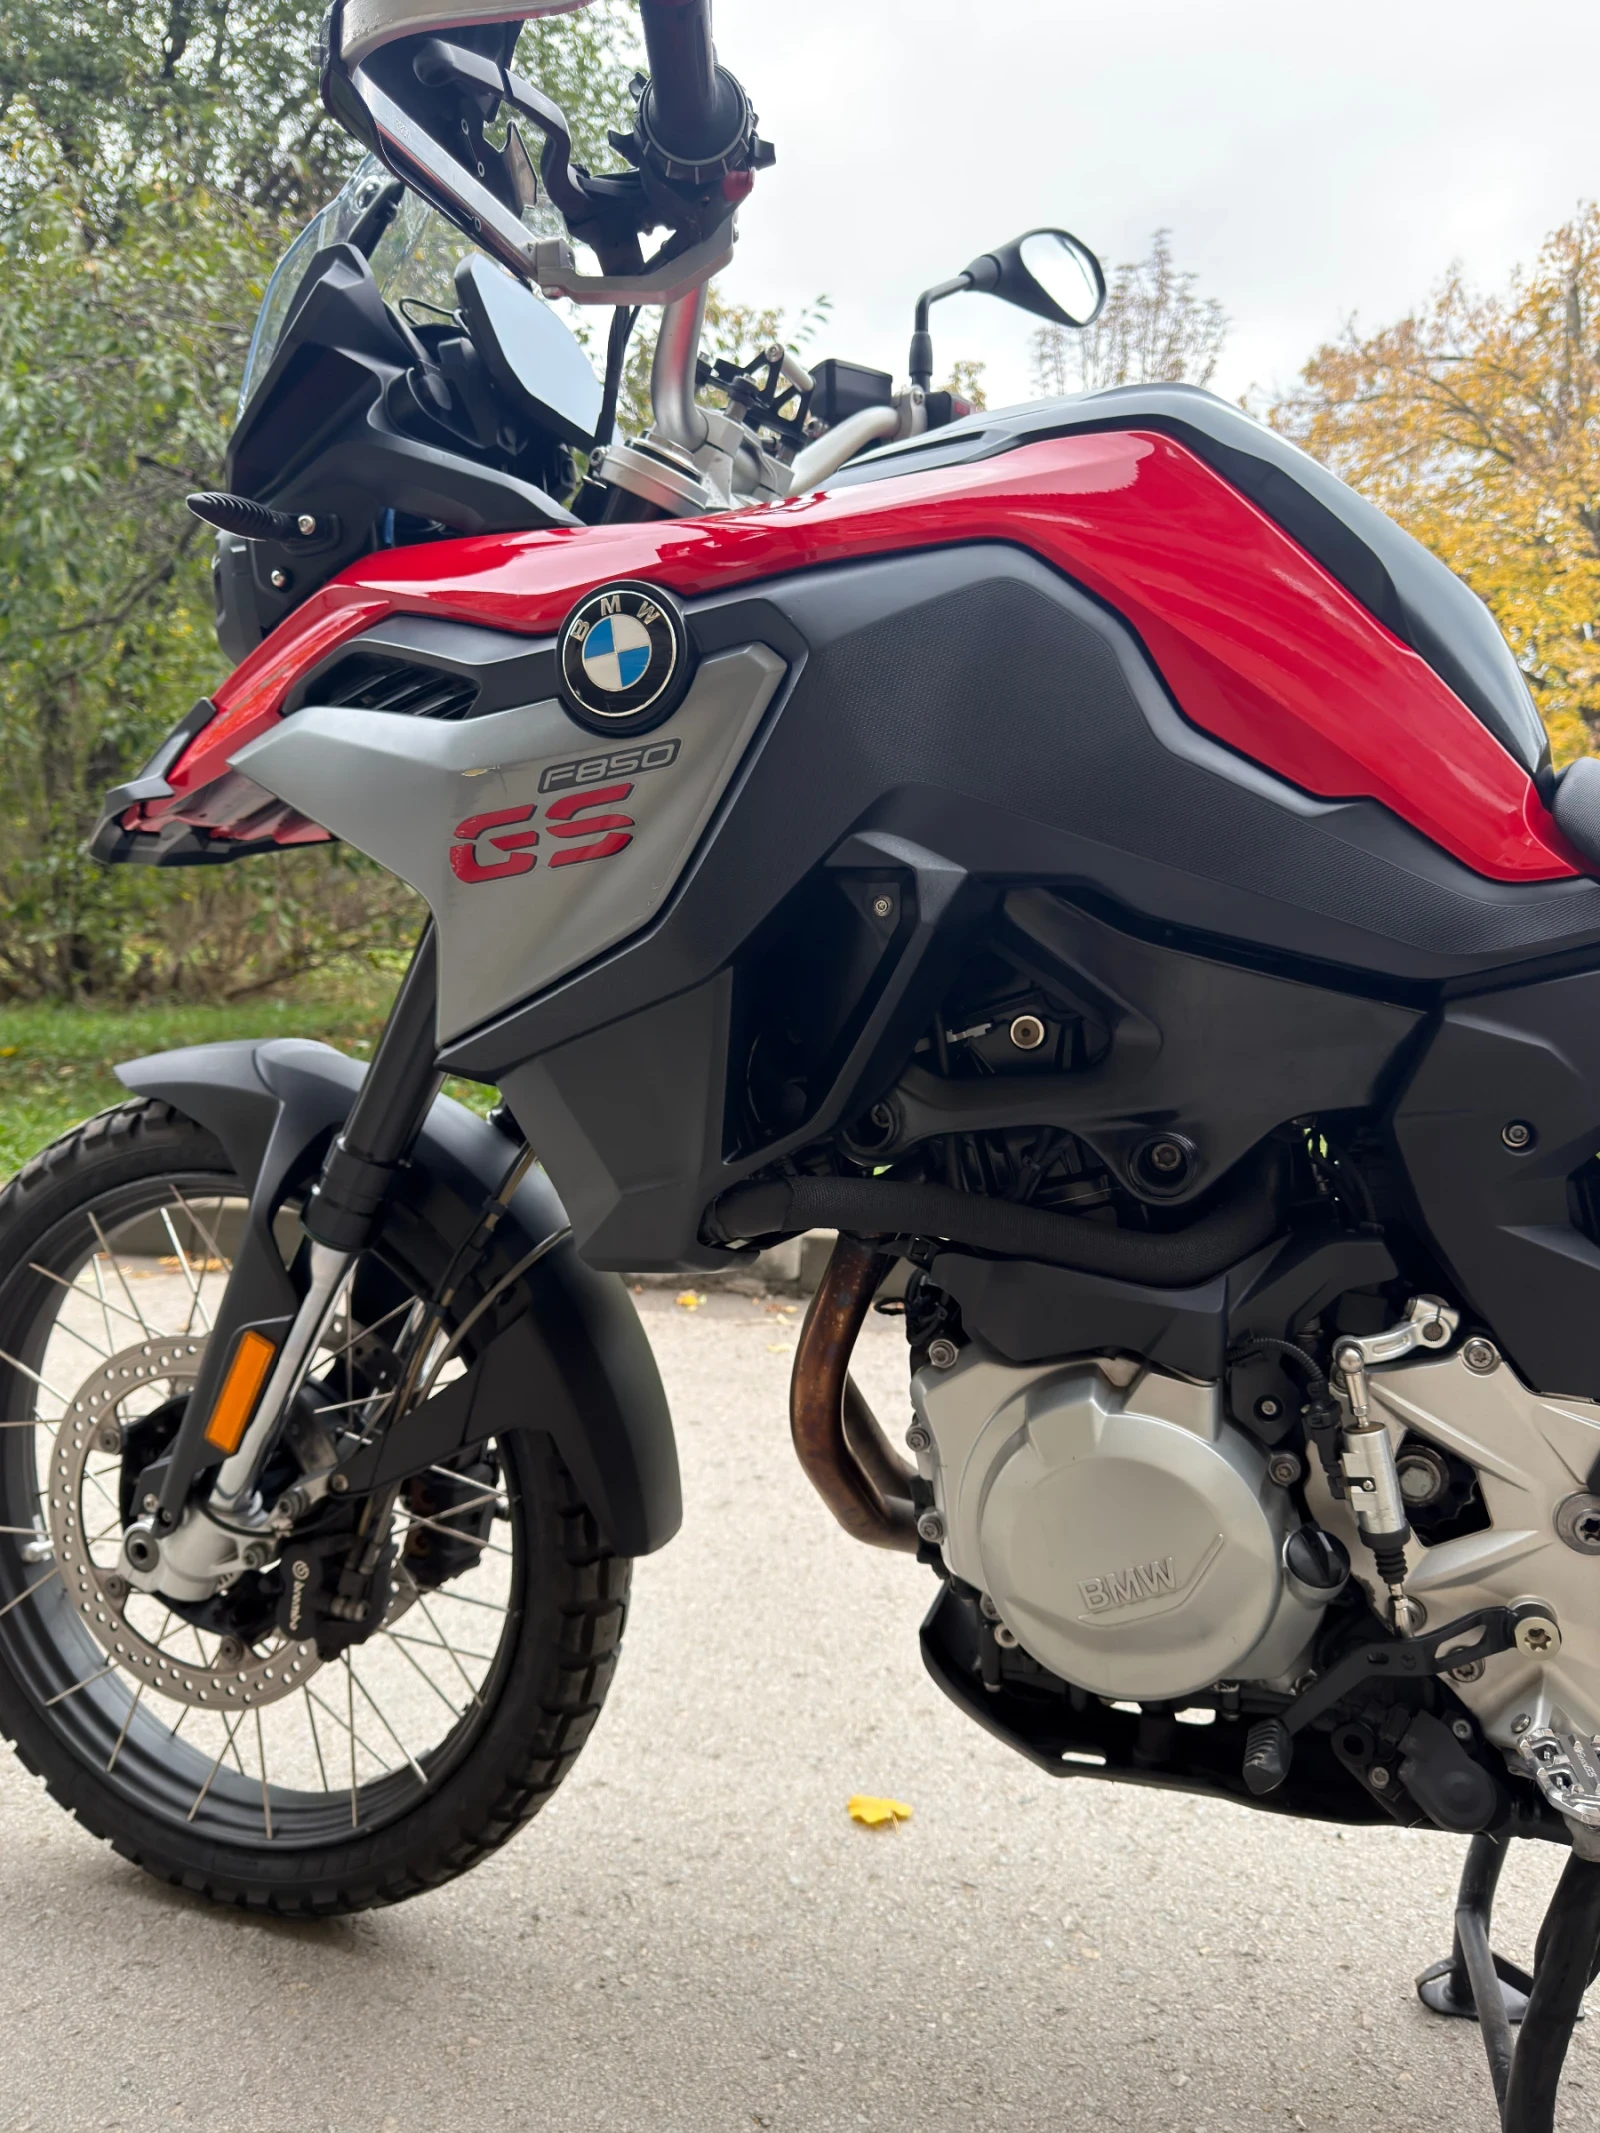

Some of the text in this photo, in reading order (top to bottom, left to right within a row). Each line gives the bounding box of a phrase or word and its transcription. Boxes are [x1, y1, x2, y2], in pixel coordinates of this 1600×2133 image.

[570, 595, 661, 642] BMW
[542, 743, 676, 790] F850
[450, 782, 635, 884] GS
[1078, 1556, 1177, 1611] BMW
